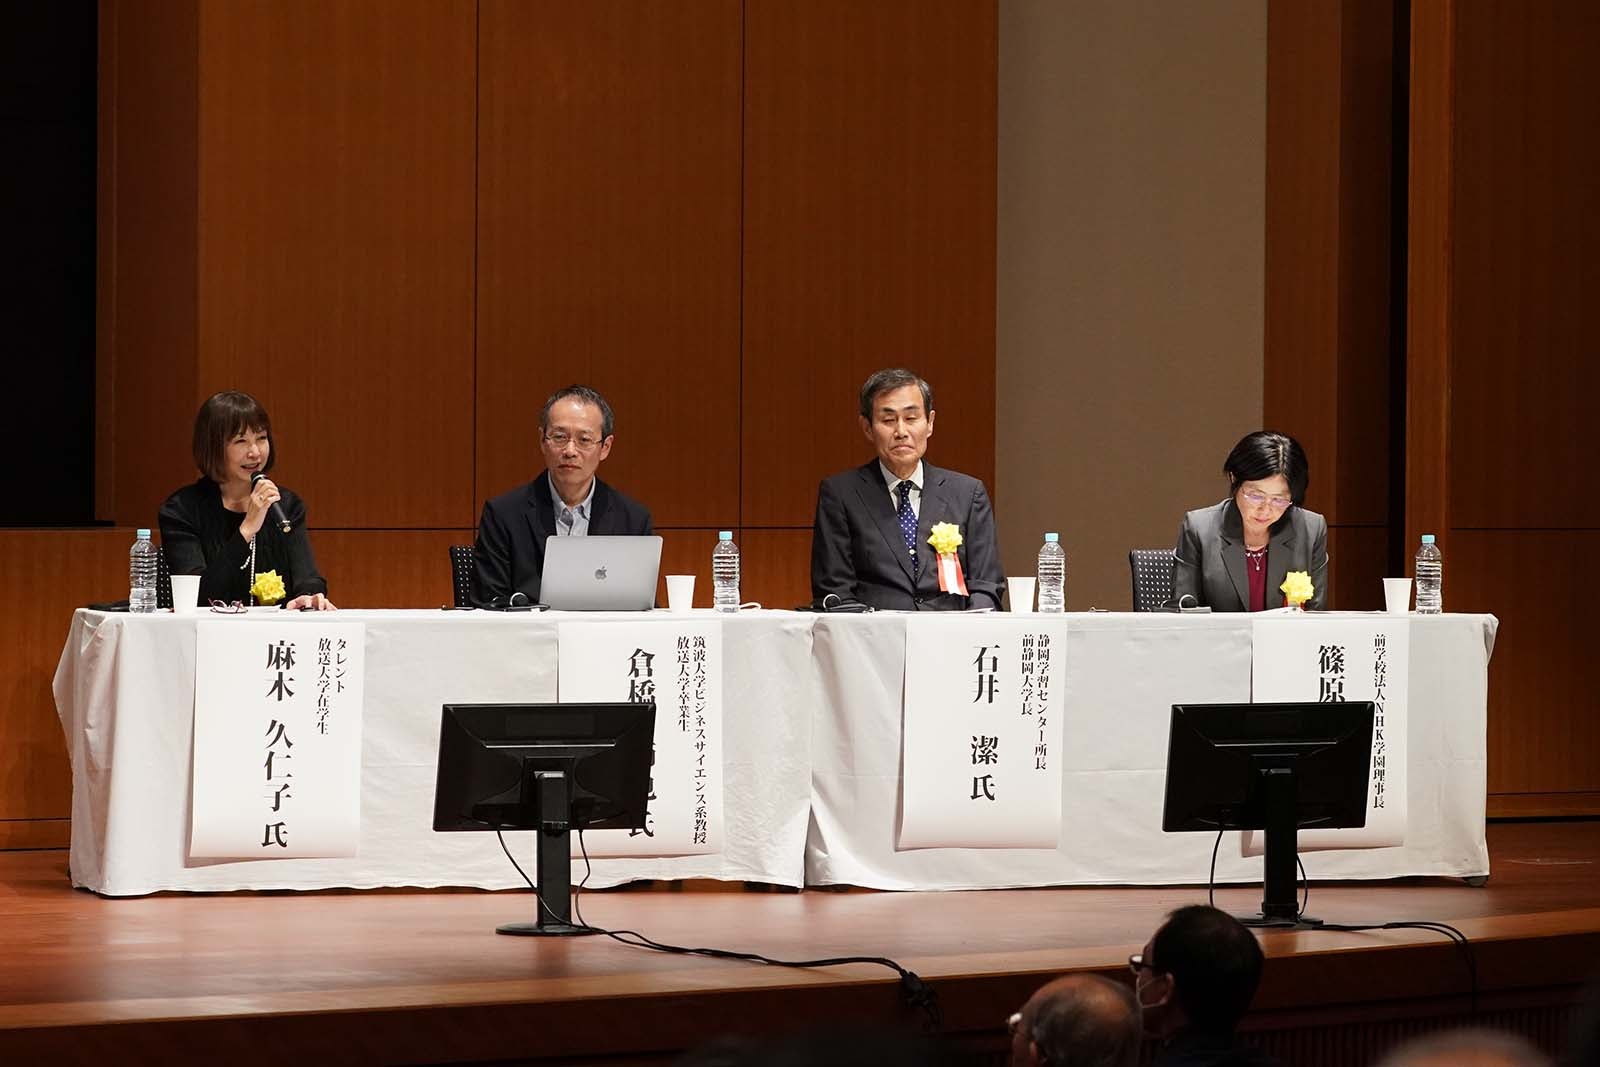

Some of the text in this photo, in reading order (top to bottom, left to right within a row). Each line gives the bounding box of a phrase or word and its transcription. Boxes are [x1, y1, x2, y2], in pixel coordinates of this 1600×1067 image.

[316, 637, 332, 735] 放送大学在学生
[336, 637, 347, 693] タレント
[627, 648, 656, 704] 倉橋
[677, 636, 690, 732] 放送大学卒業生
[972, 644, 1000, 704] 石井
[1021, 634, 1034, 715] 前静岡大学長
[1035, 634, 1050, 770] 静岡学習センター所長
[1318, 645, 1345, 702] 篠原
[261, 640, 296, 848] 麻木 久仁子 氏
[692, 636, 706, 844] 筑波大学ビジネスサイエンス系教授
[1373, 634, 1386, 808] 前学校法人NHK学園理事長
